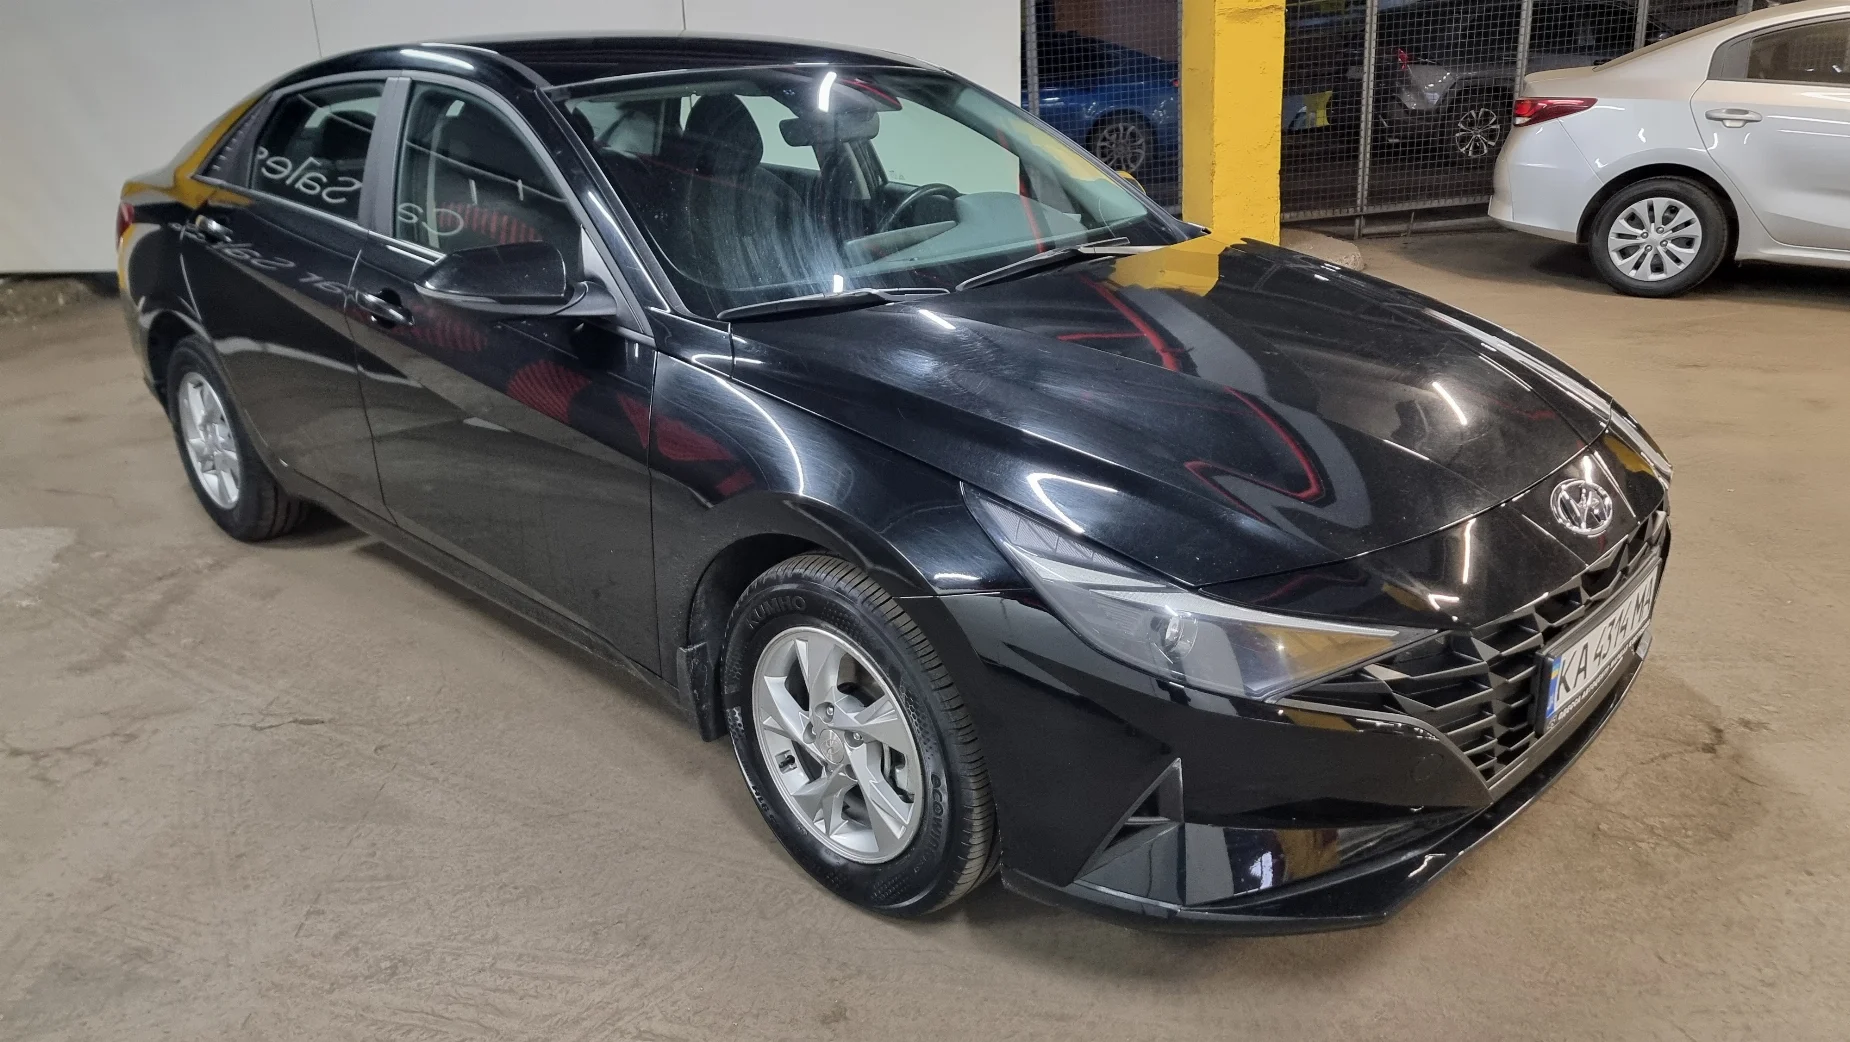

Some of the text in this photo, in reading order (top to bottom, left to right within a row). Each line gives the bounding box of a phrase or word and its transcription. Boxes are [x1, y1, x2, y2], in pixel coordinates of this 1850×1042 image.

[746, 596, 807, 630] KUMHO
[1557, 642, 1588, 702] KA
[1593, 600, 1632, 667] 4314
